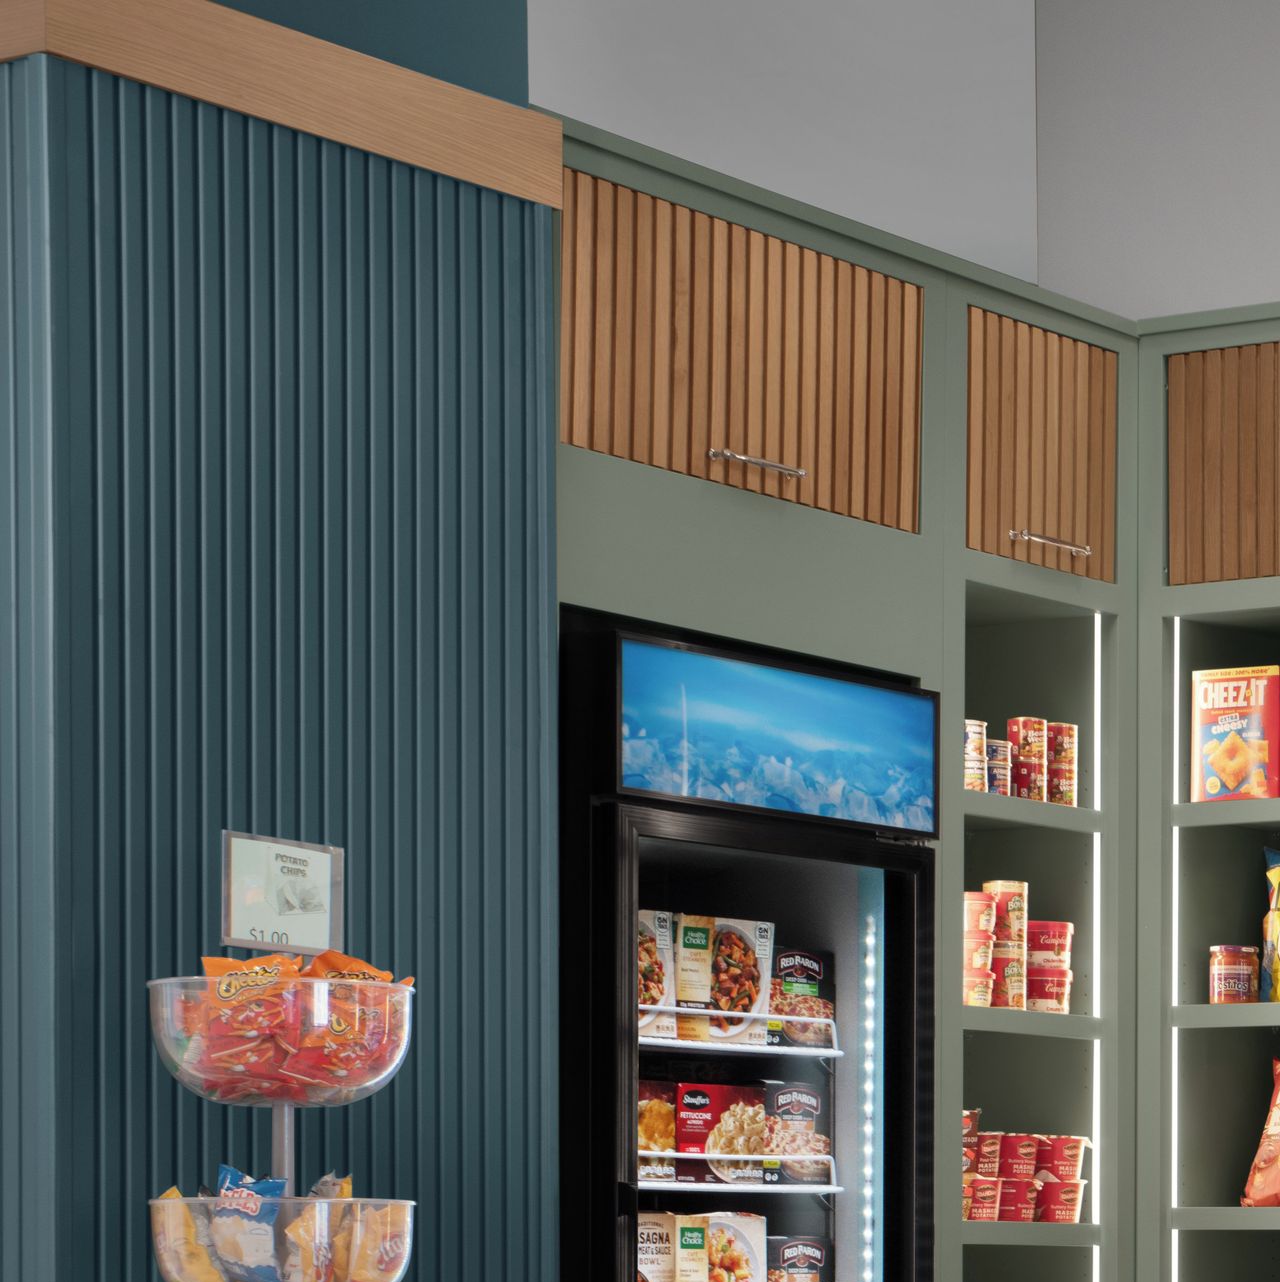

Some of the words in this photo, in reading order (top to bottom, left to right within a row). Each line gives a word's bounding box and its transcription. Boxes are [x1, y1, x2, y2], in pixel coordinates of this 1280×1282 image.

[275, 853, 308, 867] POTATO
[280, 866, 307, 878] CHIPS
[684, 936, 707, 945] Choice
[780, 955, 794, 967] RED
[795, 953, 819, 970] BARON
[216, 966, 280, 1000] Cheetos
[778, 1091, 792, 1105] RED
[792, 1090, 817, 1107] BARON
[680, 1112, 712, 1120] FETTUCCINE
[682, 1237, 704, 1245] Choice
[784, 1247, 797, 1259] RED
[797, 1245, 821, 1259] BARON
